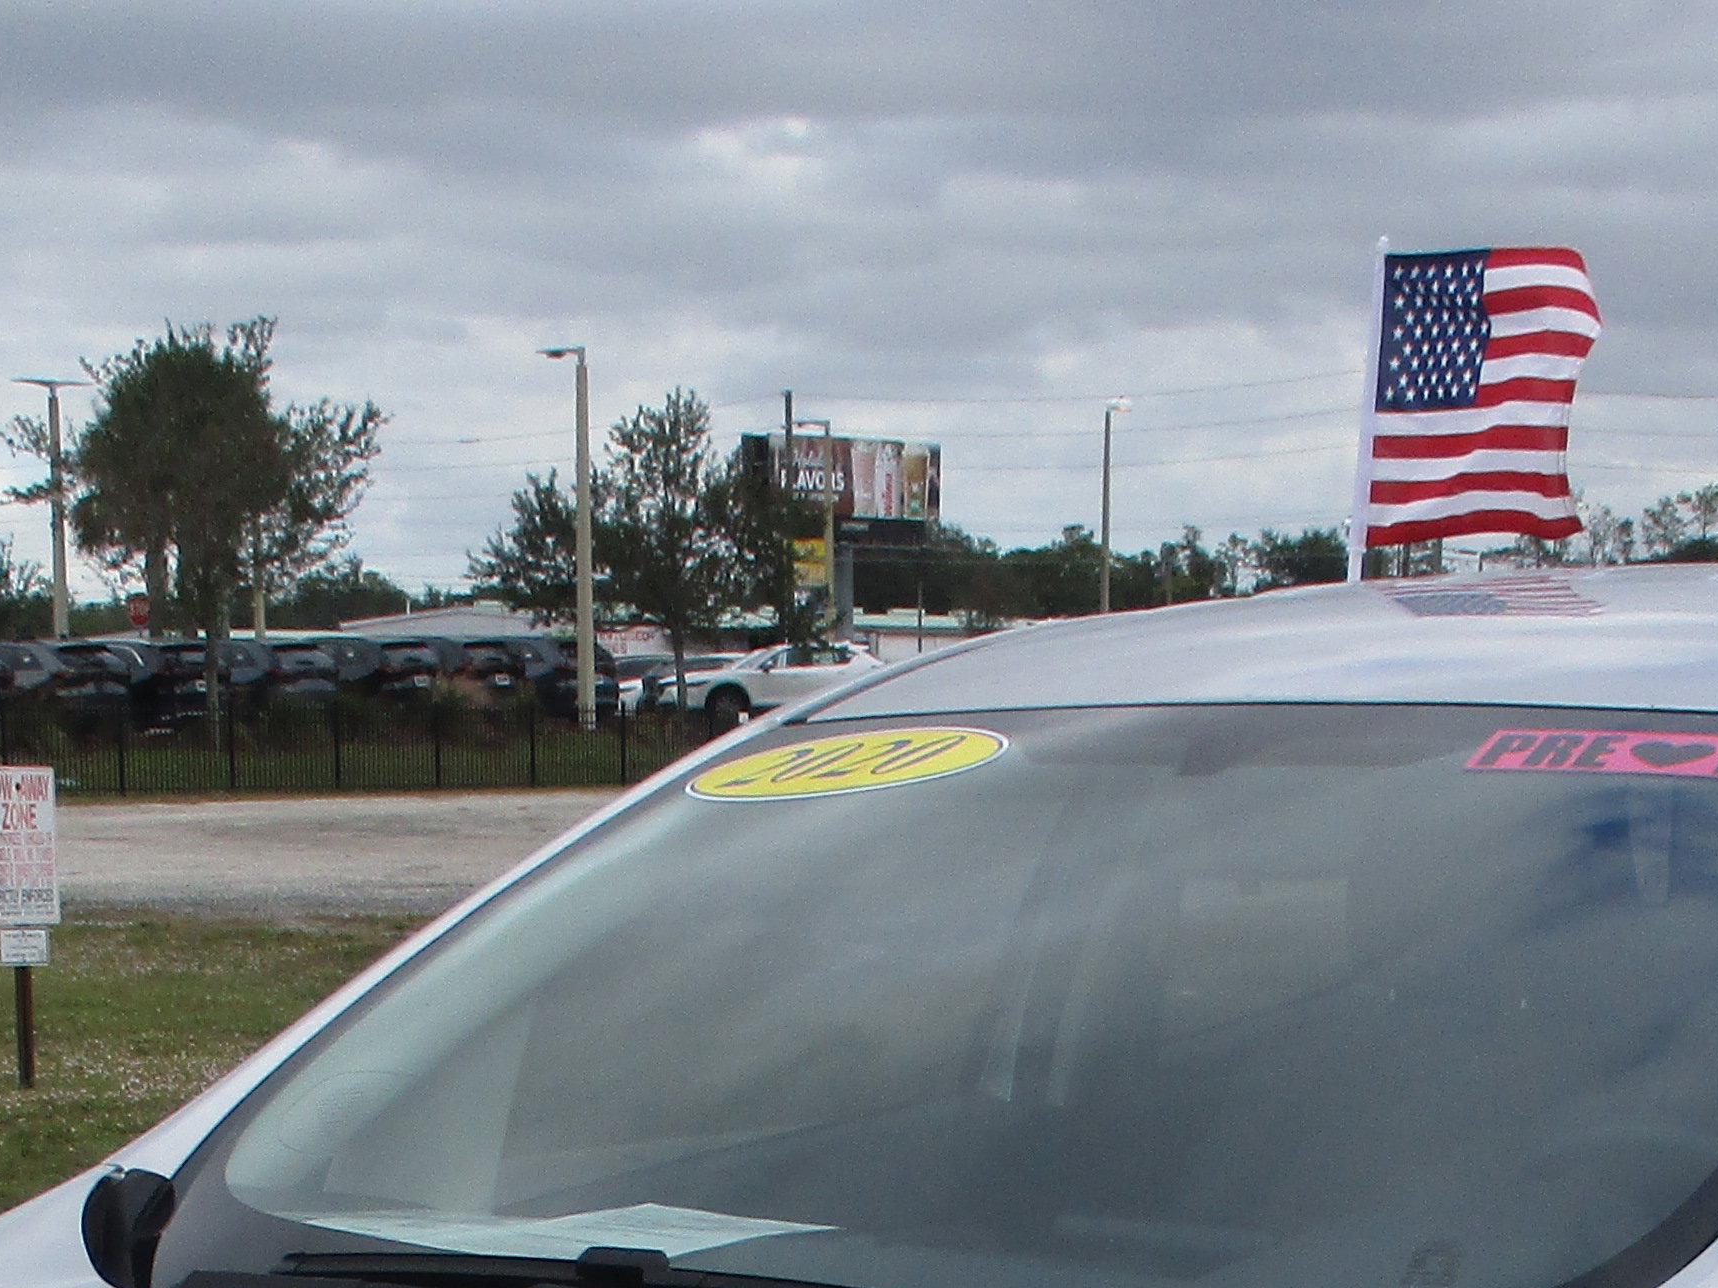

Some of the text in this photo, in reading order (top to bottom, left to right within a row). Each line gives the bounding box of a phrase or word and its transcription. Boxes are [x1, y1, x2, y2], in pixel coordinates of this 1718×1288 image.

[714, 735, 967, 788] 2020
[1478, 733, 1628, 769] PRE
[2, 803, 37, 830] ZONE
